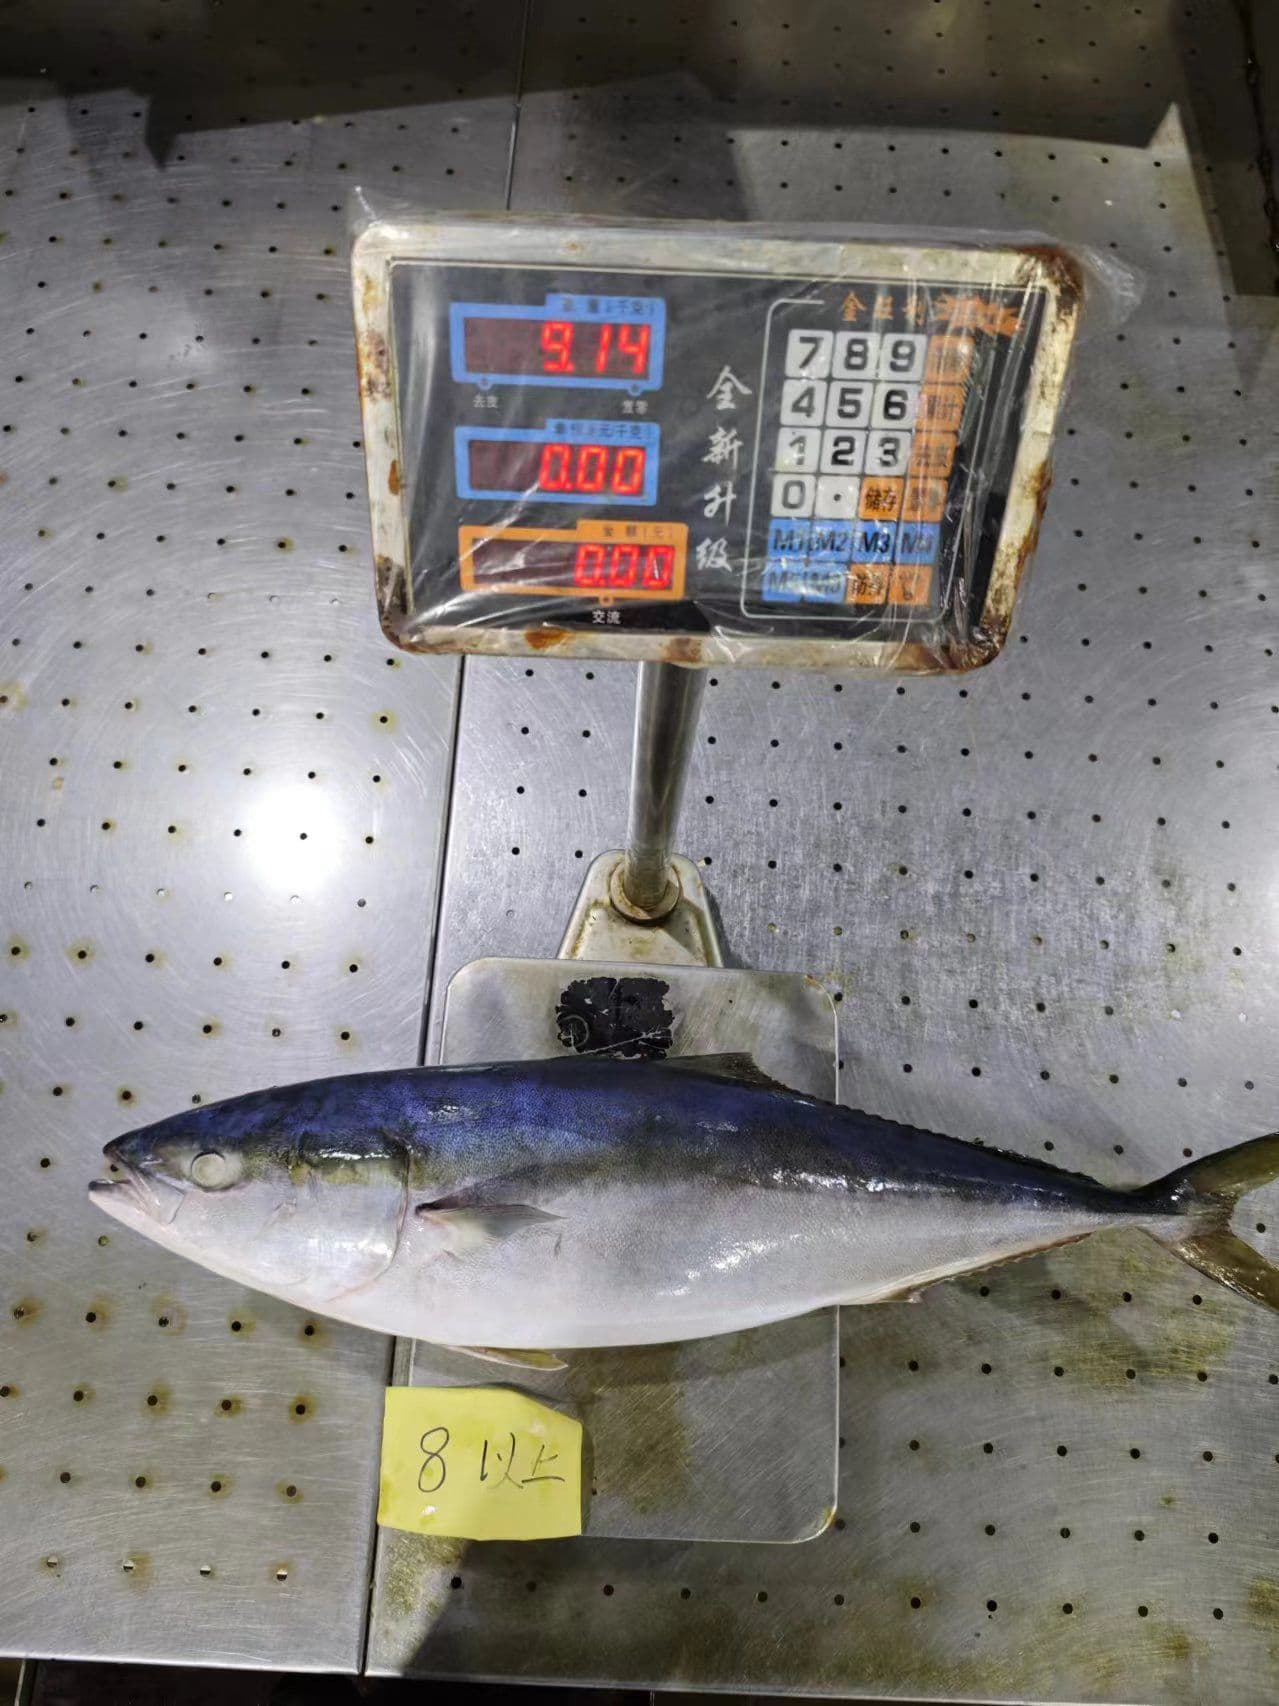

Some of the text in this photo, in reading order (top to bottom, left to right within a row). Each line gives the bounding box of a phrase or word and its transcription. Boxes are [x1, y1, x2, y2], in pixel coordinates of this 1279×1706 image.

[799, 336, 824, 370] 7
[844, 338, 869, 371] 8
[890, 339, 918, 372] 9
[791, 386, 816, 418] 4
[837, 387, 864, 419] 5
[883, 389, 909, 420] 6
[695, 364, 753, 572] 全新升级
[789, 435, 808, 466] 1
[831, 436, 855, 466] 2
[878, 437, 899, 468] 3
[538, 443, 647, 495] 0.00
[781, 480, 806, 509] 0
[817, 530, 848, 551] M2
[859, 531, 890, 553] M3
[592, 609, 621, 625] 交流
[418, 1426, 450, 1493] 8
